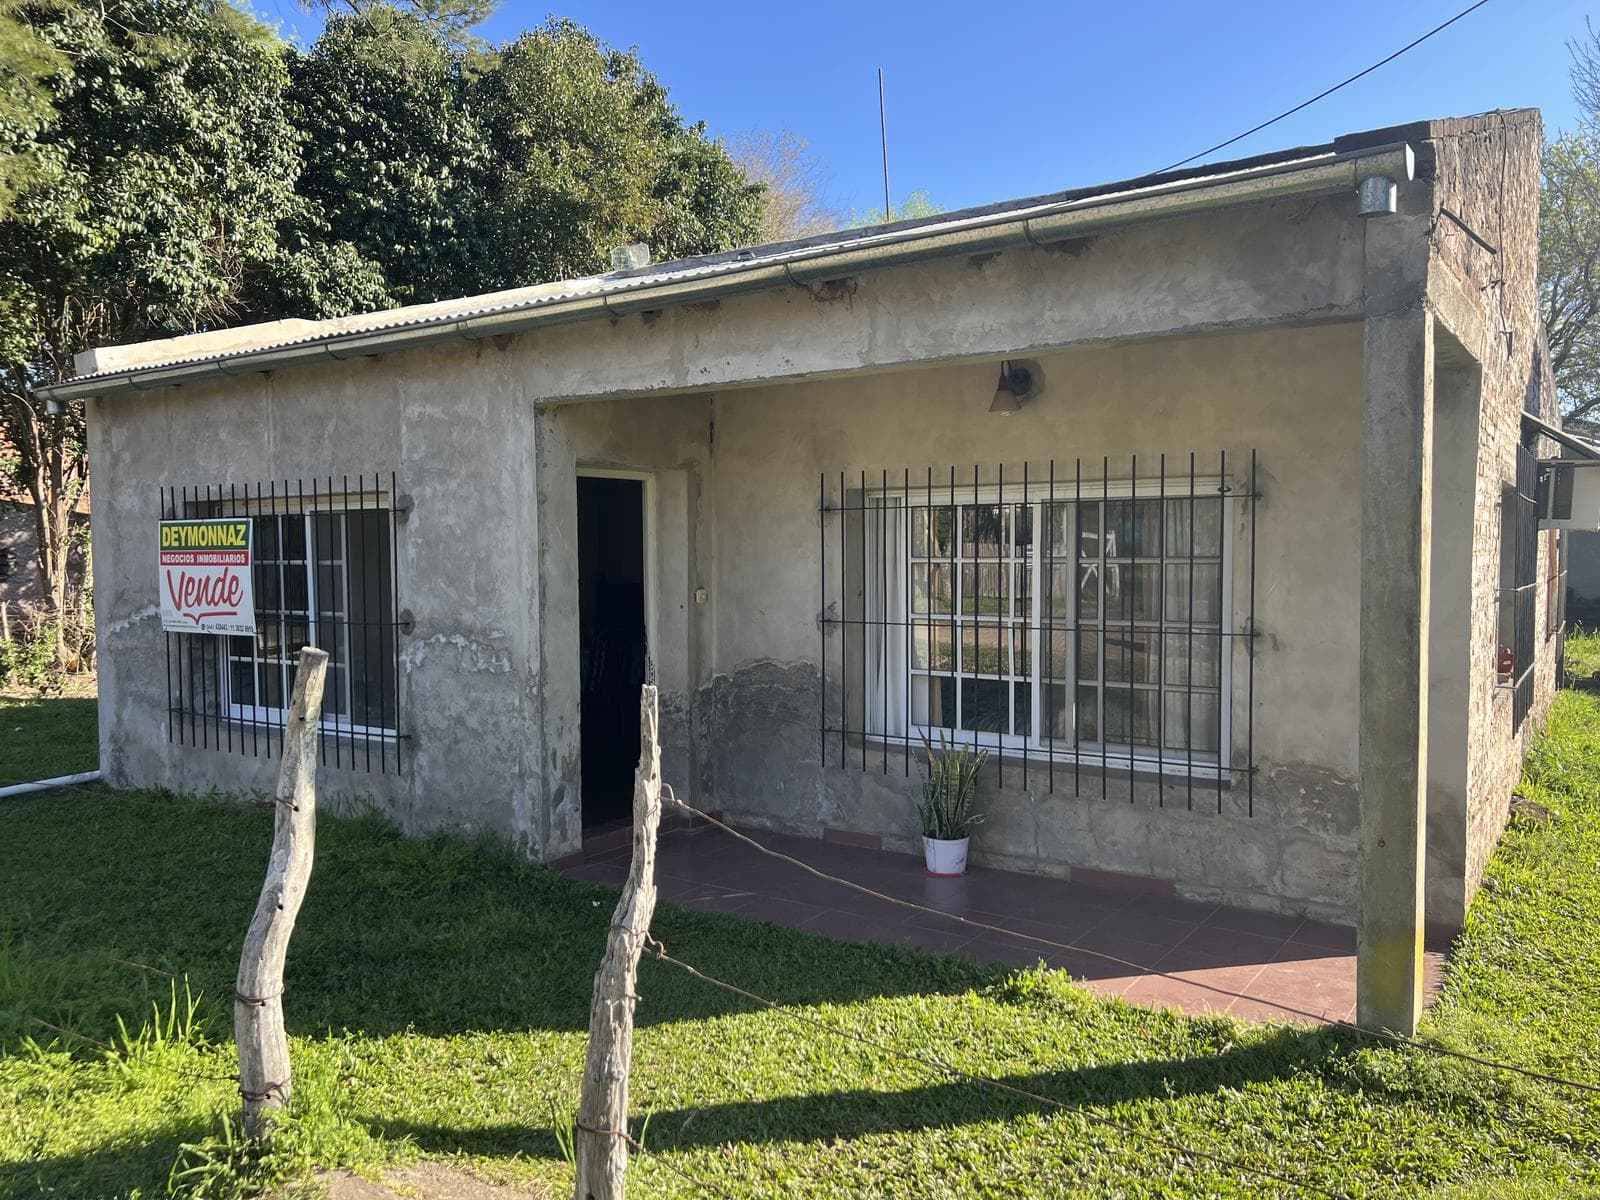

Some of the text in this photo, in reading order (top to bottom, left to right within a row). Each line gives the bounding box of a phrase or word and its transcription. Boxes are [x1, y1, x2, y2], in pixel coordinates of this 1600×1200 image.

[162, 525, 246, 546] DEYMONNAZ
[162, 554, 245, 563] NEGOCIOS INMOBILIARIOS
[166, 566, 244, 611] Vende
